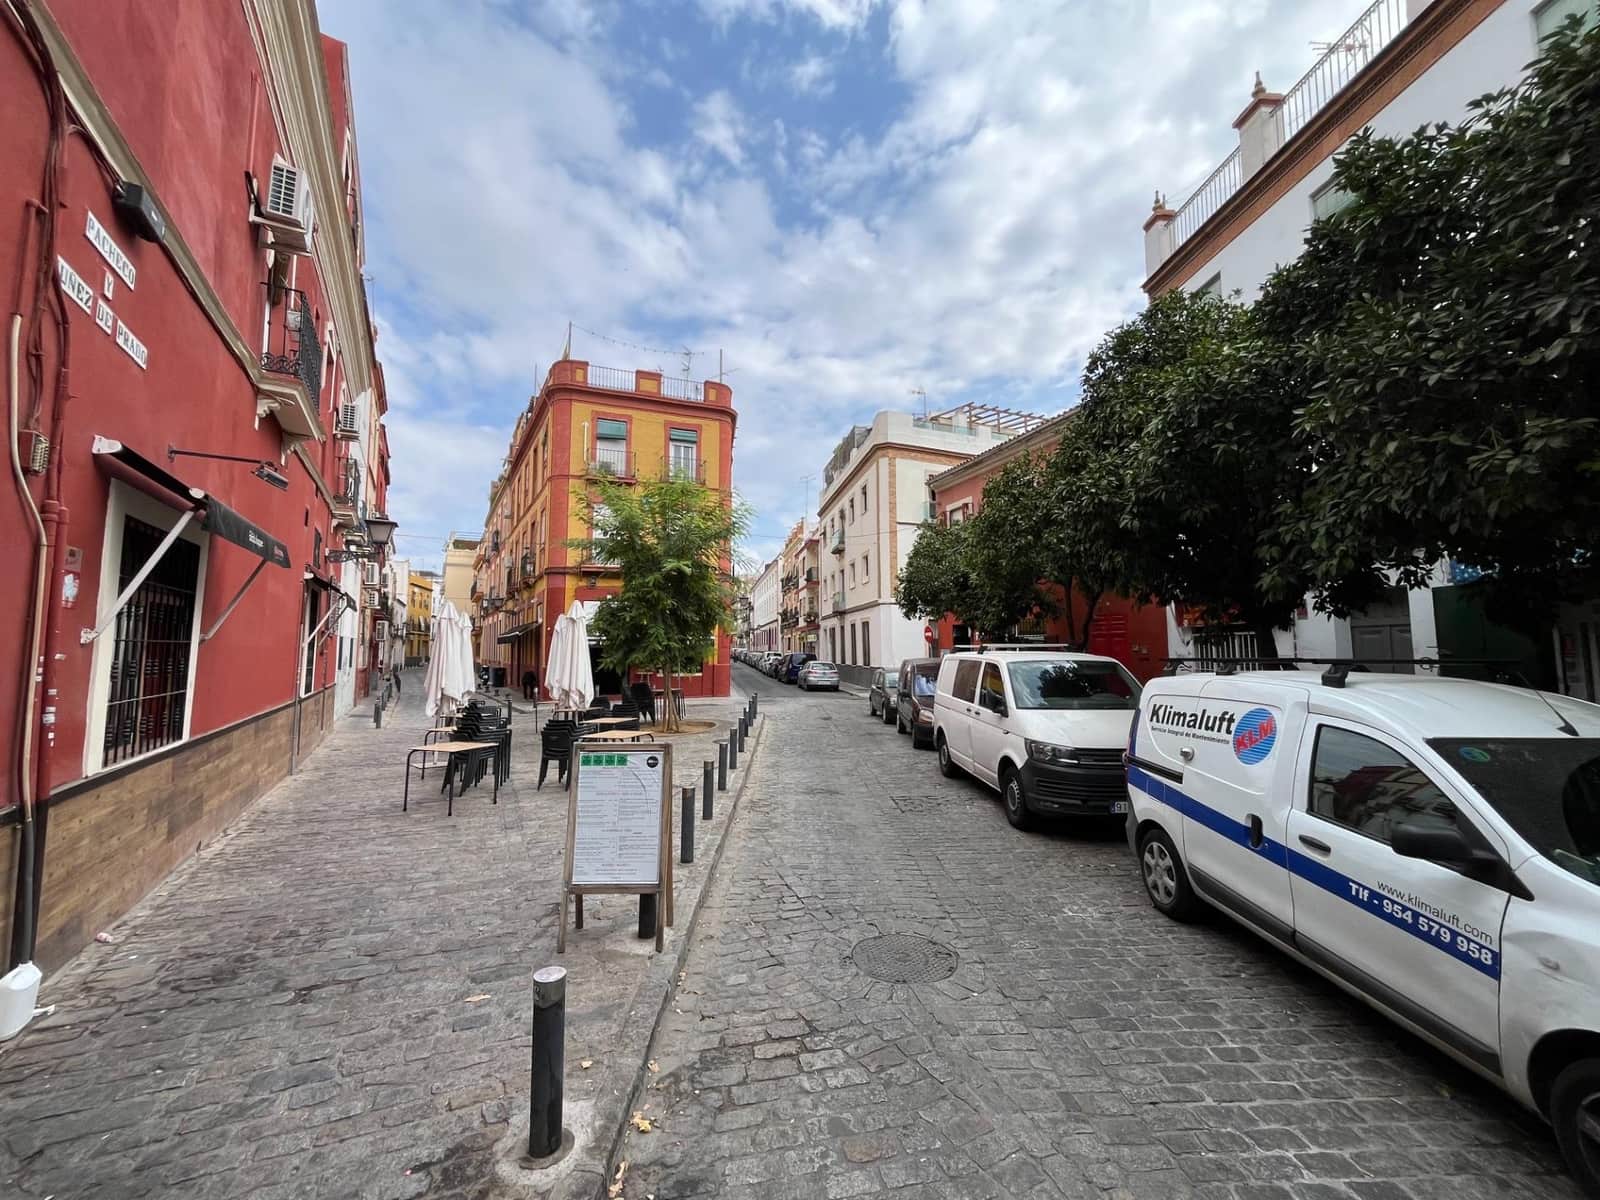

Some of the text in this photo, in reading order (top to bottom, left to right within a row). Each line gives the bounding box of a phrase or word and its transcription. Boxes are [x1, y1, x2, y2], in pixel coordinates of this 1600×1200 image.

[87, 217, 136, 286] PACHECO
[106, 275, 114, 294] Y
[97, 302, 113, 329] DE
[117, 322, 147, 365] PRADO
[1150, 703, 1235, 735] Klimaluft
[1235, 714, 1275, 757] KLM
[1349, 882, 1370, 902] Tlf
[1382, 899, 1413, 924] 954
[1417, 917, 1451, 943] 579
[1456, 935, 1493, 966] 958
[1376, 880, 1493, 945] www.klimaluft.com
